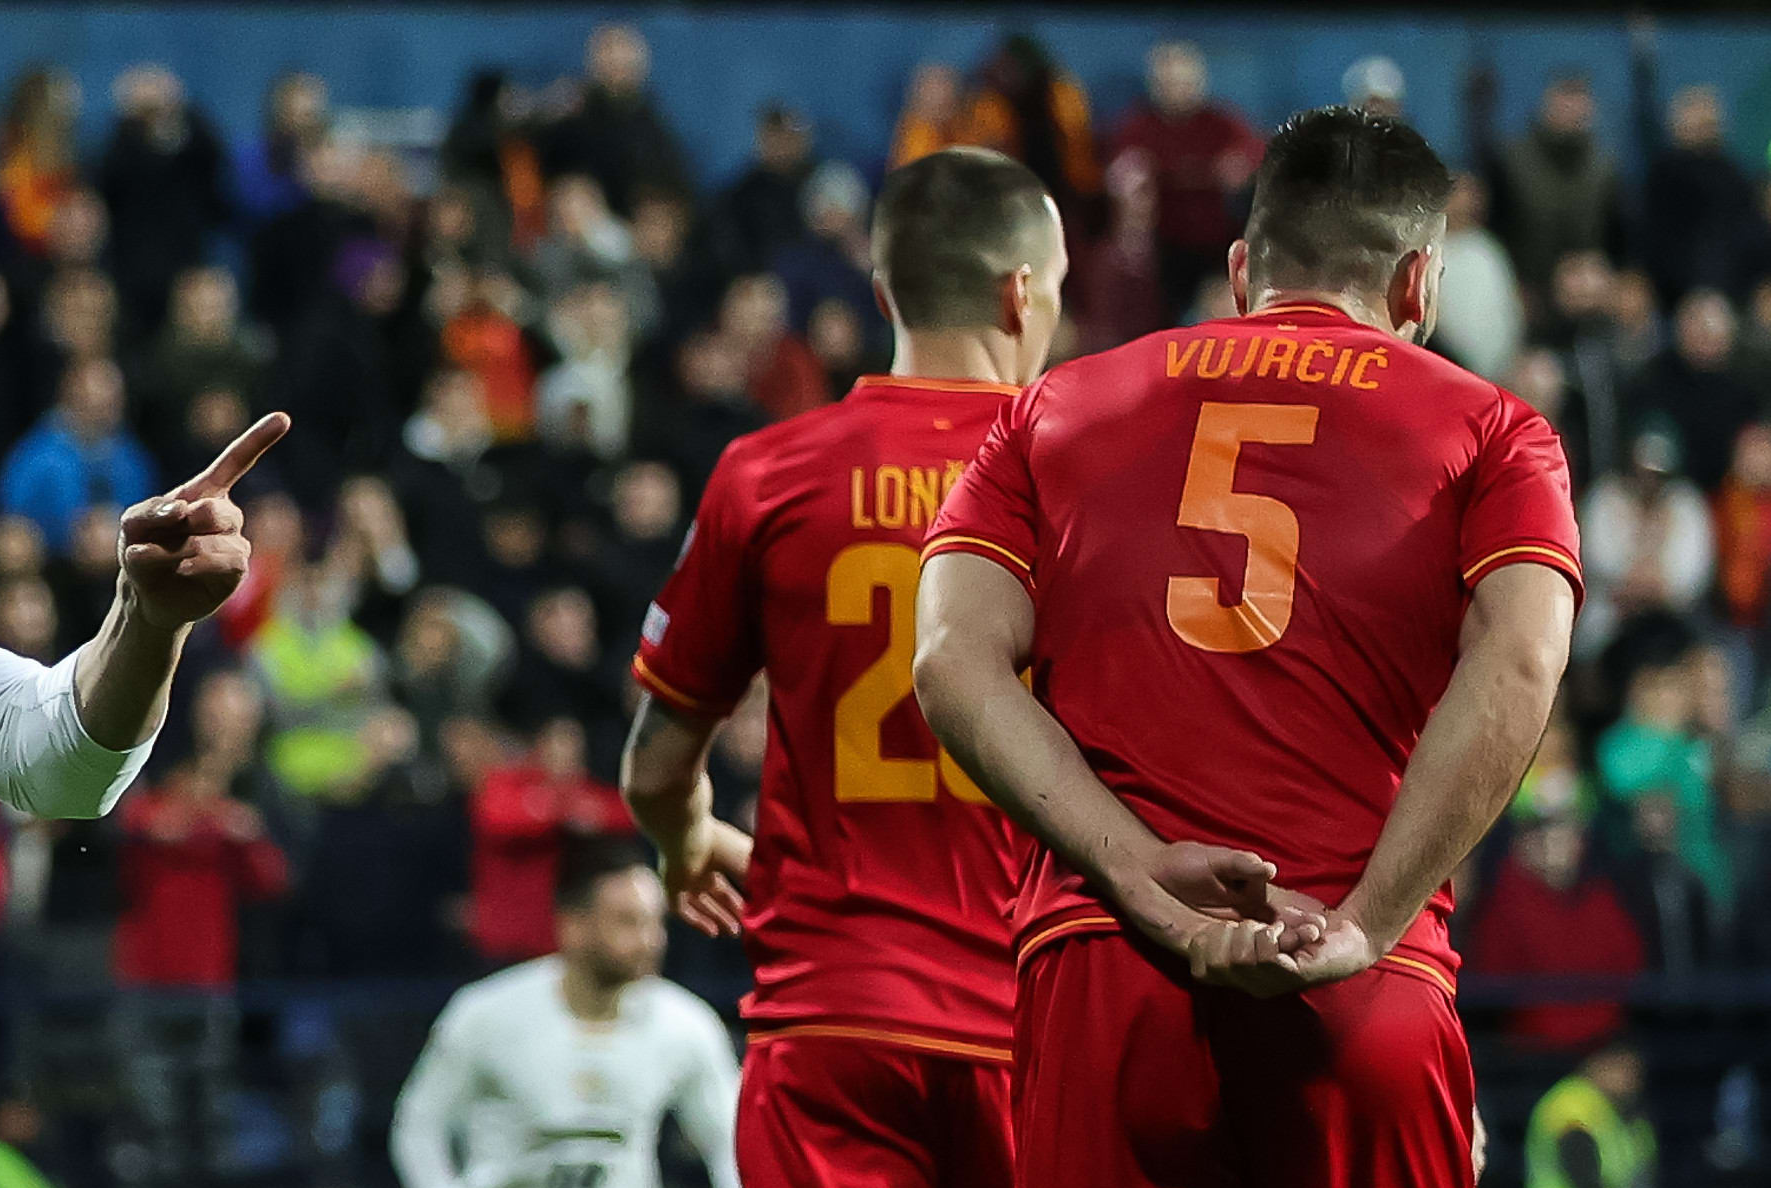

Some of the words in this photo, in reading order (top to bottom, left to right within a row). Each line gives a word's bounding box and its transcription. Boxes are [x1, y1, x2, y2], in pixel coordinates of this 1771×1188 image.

[1166, 335, 1389, 390] VUJAČIĆ
[1166, 401, 1320, 653] 5
[827, 541, 1032, 804] 2
